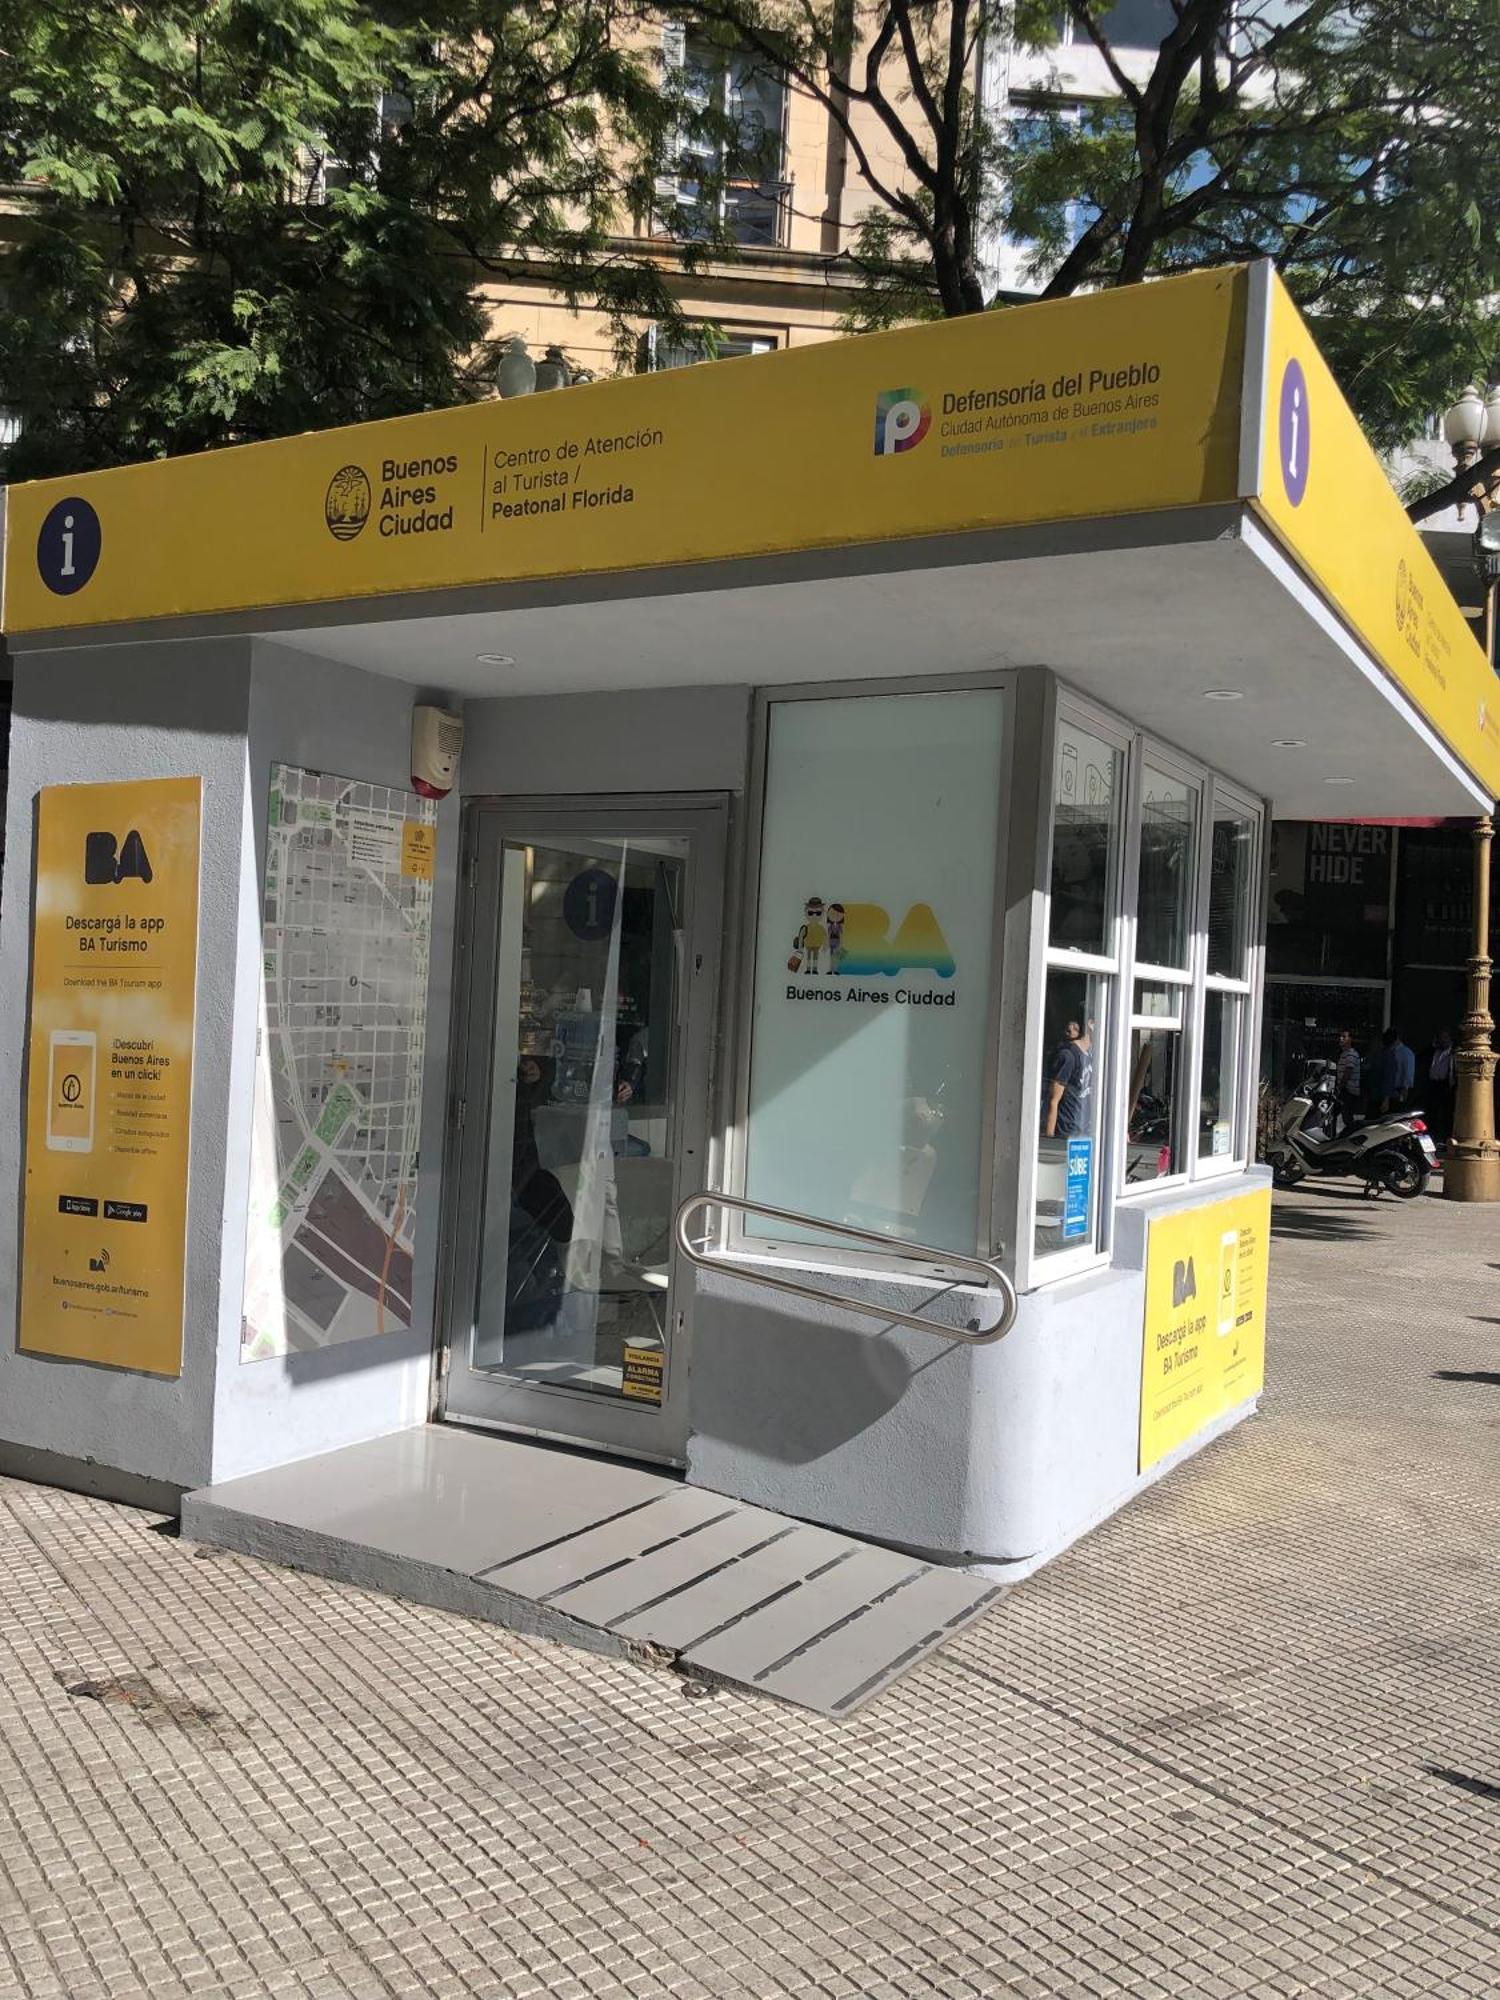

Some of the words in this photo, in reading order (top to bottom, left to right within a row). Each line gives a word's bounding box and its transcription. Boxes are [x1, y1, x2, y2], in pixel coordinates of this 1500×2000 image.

[943, 379, 1046, 415] Defensoría
[1052, 373, 1082, 399] del
[1089, 362, 1160, 393] Pueblo
[941, 420, 982, 437] Ciudad
[985, 411, 1048, 432] Autónoma
[1053, 406, 1068, 420] de
[1073, 400, 1121, 418] Buenos
[1125, 394, 1159, 410] Aires
[494, 448, 550, 469] Centro
[556, 440, 578, 460] de
[584, 428, 663, 456] Atención
[382, 455, 457, 482] Buenos
[492, 475, 507, 494] al
[513, 469, 569, 492] Turista
[380, 486, 436, 510] Aires
[492, 492, 566, 519] Peatonal
[572, 483, 635, 510] Florida
[379, 505, 453, 537] Ciudad
[1311, 823, 1387, 854] NEVER
[85, 829, 153, 885] BA
[1310, 855, 1364, 885] HIDE
[66, 915, 121, 934] Descargá
[125, 915, 136, 929] la
[140, 917, 165, 934] app
[80, 937, 96, 952] BA
[99, 937, 148, 952] Turismo
[786, 986, 842, 1002] Buenos
[846, 988, 889, 1004] Aires
[895, 990, 956, 1006] Ciudad
[111, 1053, 144, 1065] Buenos
[146, 1055, 171, 1067] Aires
[111, 1069, 122, 1079] en
[124, 1069, 136, 1080] un
[1069, 1156, 1088, 1177] SUBE
[89, 1258, 106, 1273] BA
[1173, 1255, 1197, 1309] BA
[1156, 1321, 1186, 1352] Descargá
[1194, 1315, 1207, 1335] app
[627, 1364, 659, 1377] ALARMA
[1163, 1357, 1173, 1376] BA
[1174, 1345, 1199, 1369] Turismo
